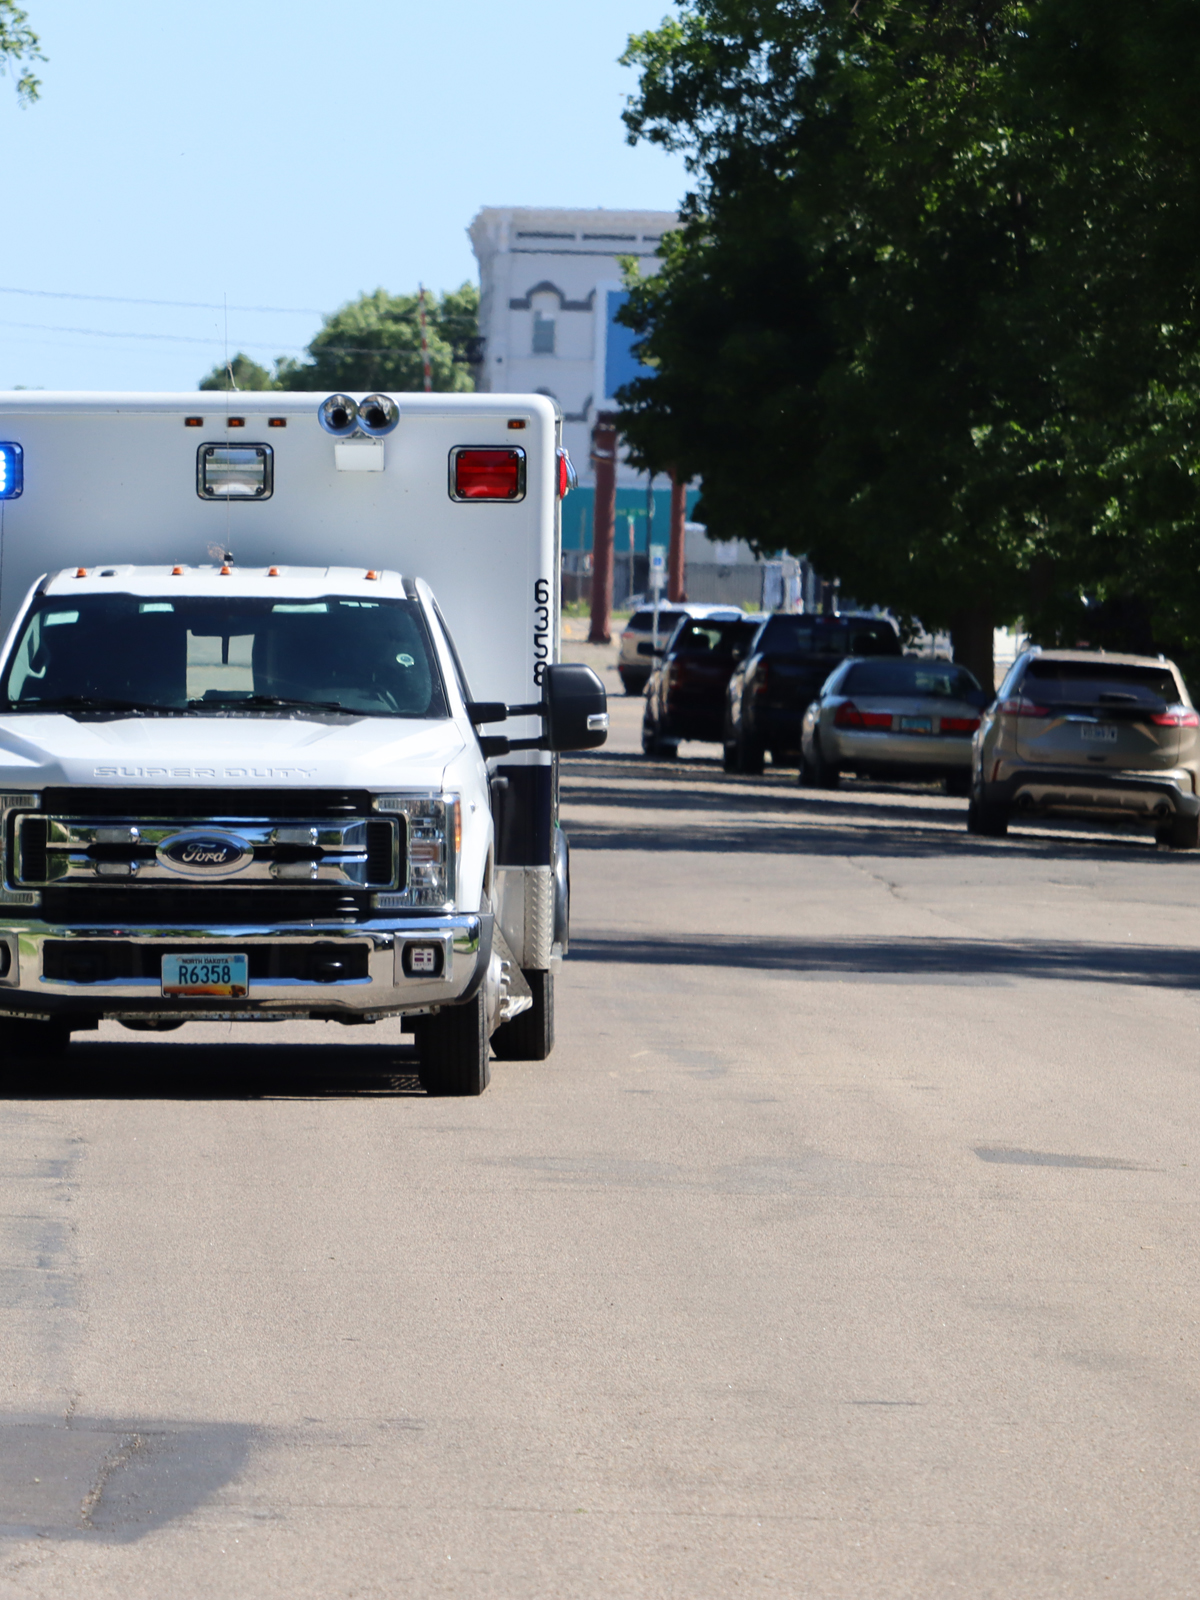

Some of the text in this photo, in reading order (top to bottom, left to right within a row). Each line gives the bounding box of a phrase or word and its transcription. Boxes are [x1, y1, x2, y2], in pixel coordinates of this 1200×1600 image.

[93, 766, 318, 778] SUPER DUTY
[181, 842, 227, 863] Ford
[179, 965, 231, 985] R6358
